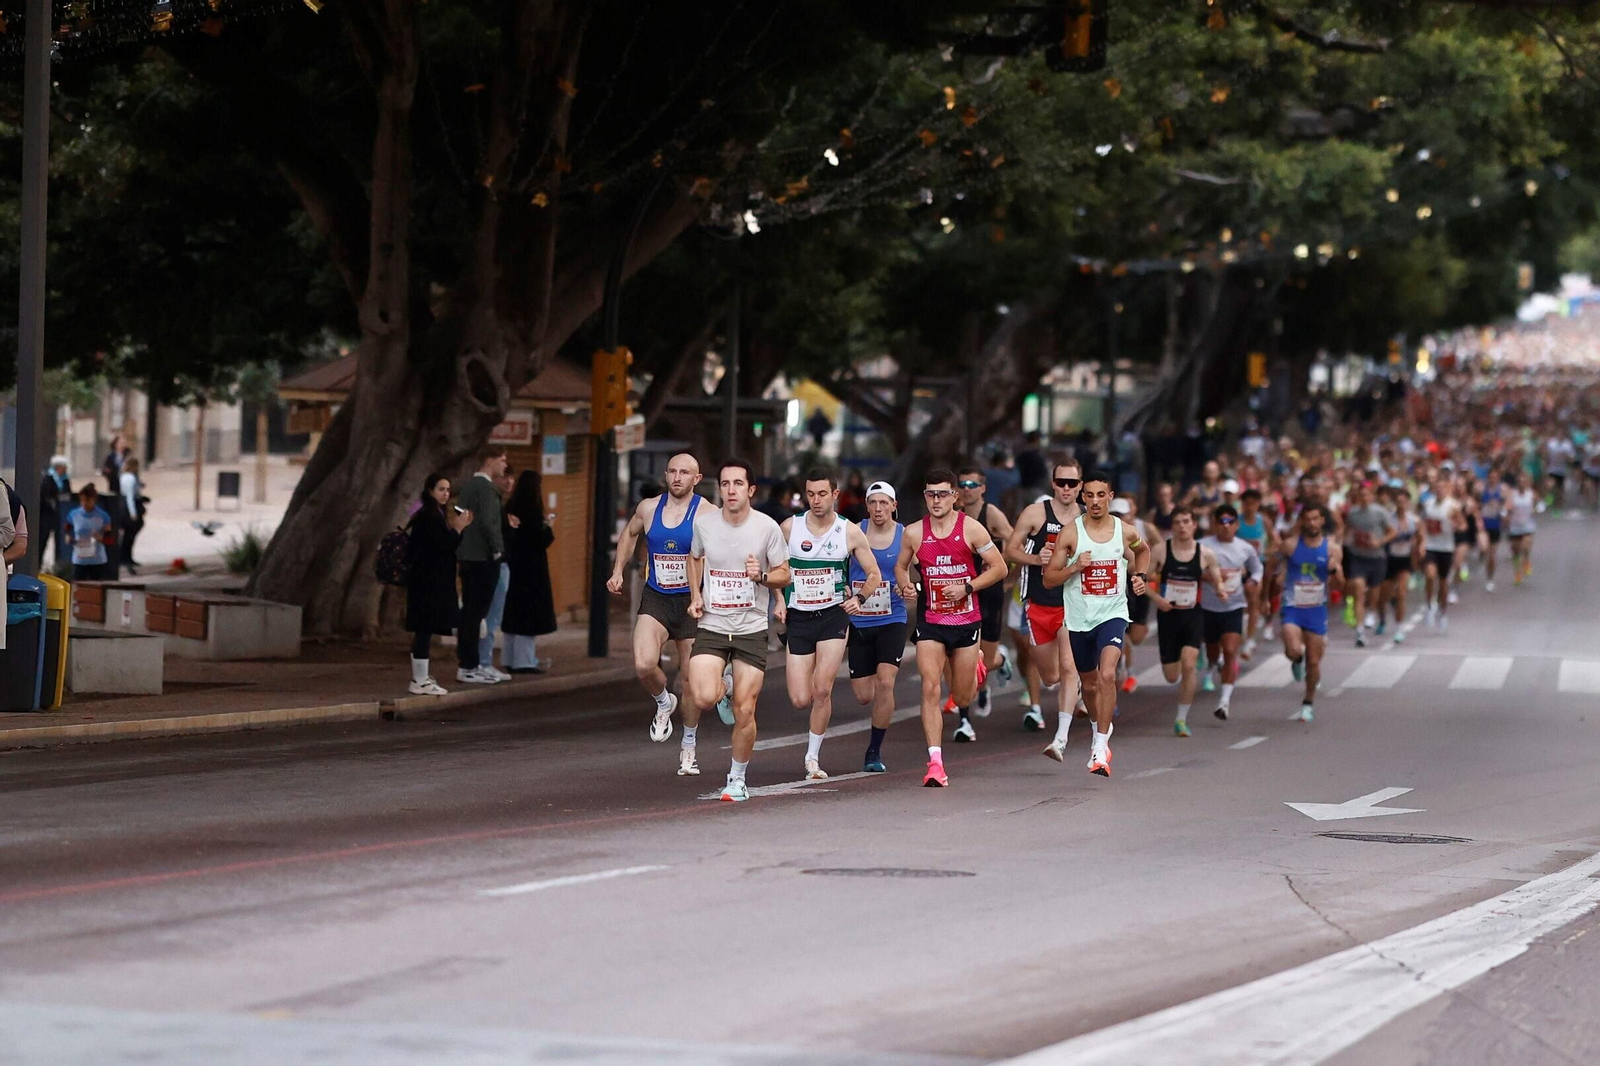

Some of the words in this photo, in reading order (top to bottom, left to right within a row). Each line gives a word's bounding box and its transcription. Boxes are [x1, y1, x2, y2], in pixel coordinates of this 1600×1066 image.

[1047, 523, 1061, 533] BRC
[936, 555, 952, 565] PEAK
[717, 580, 742, 588] 14573
[801, 577, 825, 585] 14625
